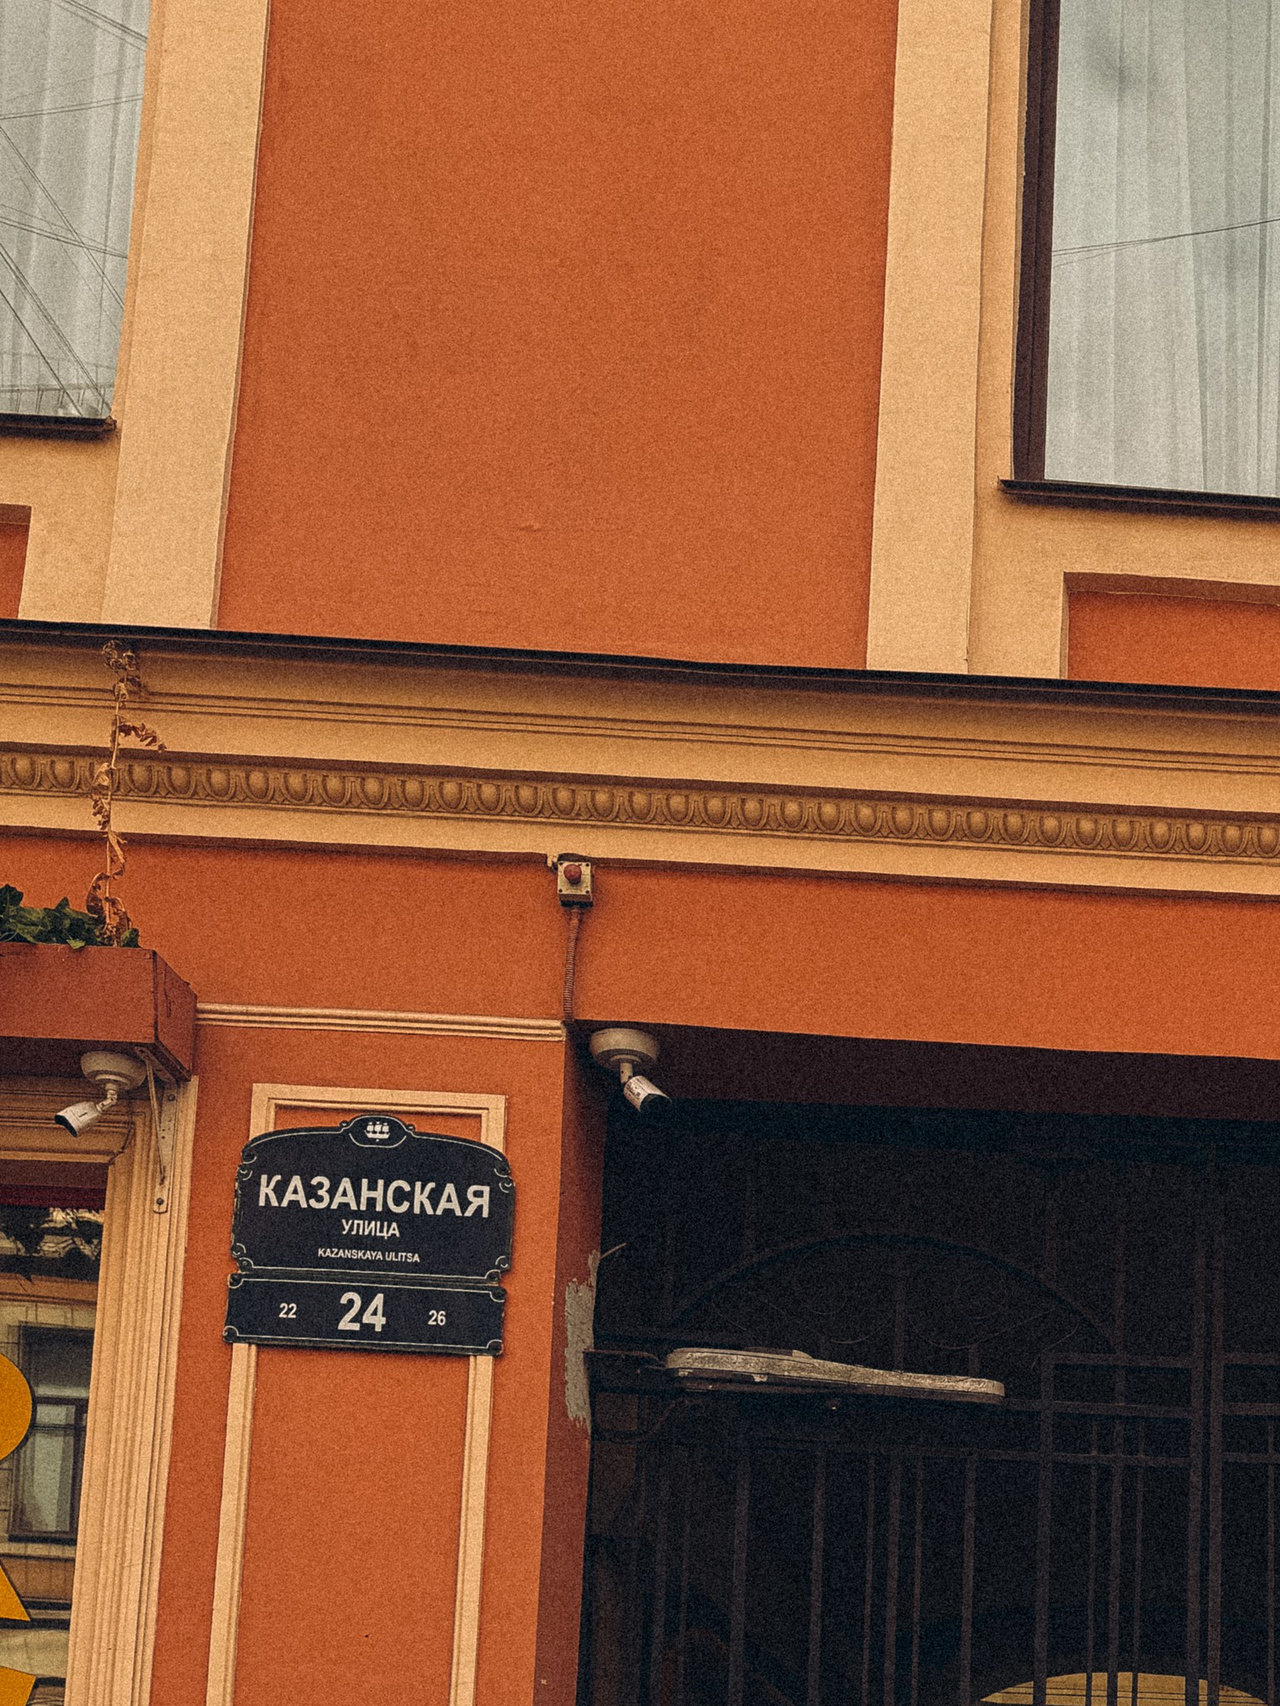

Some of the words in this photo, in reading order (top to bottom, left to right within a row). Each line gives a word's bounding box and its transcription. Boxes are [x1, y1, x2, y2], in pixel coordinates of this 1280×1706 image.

[258, 1173, 491, 1219] КАЗАНСКАЯ
[341, 1219, 400, 1240] УЛИЦА
[317, 1247, 383, 1261] KAZANSKAYA
[385, 1251, 420, 1263] ULITSA
[278, 1302, 298, 1319] 22
[337, 1291, 387, 1333] 24
[427, 1309, 447, 1327] 26
